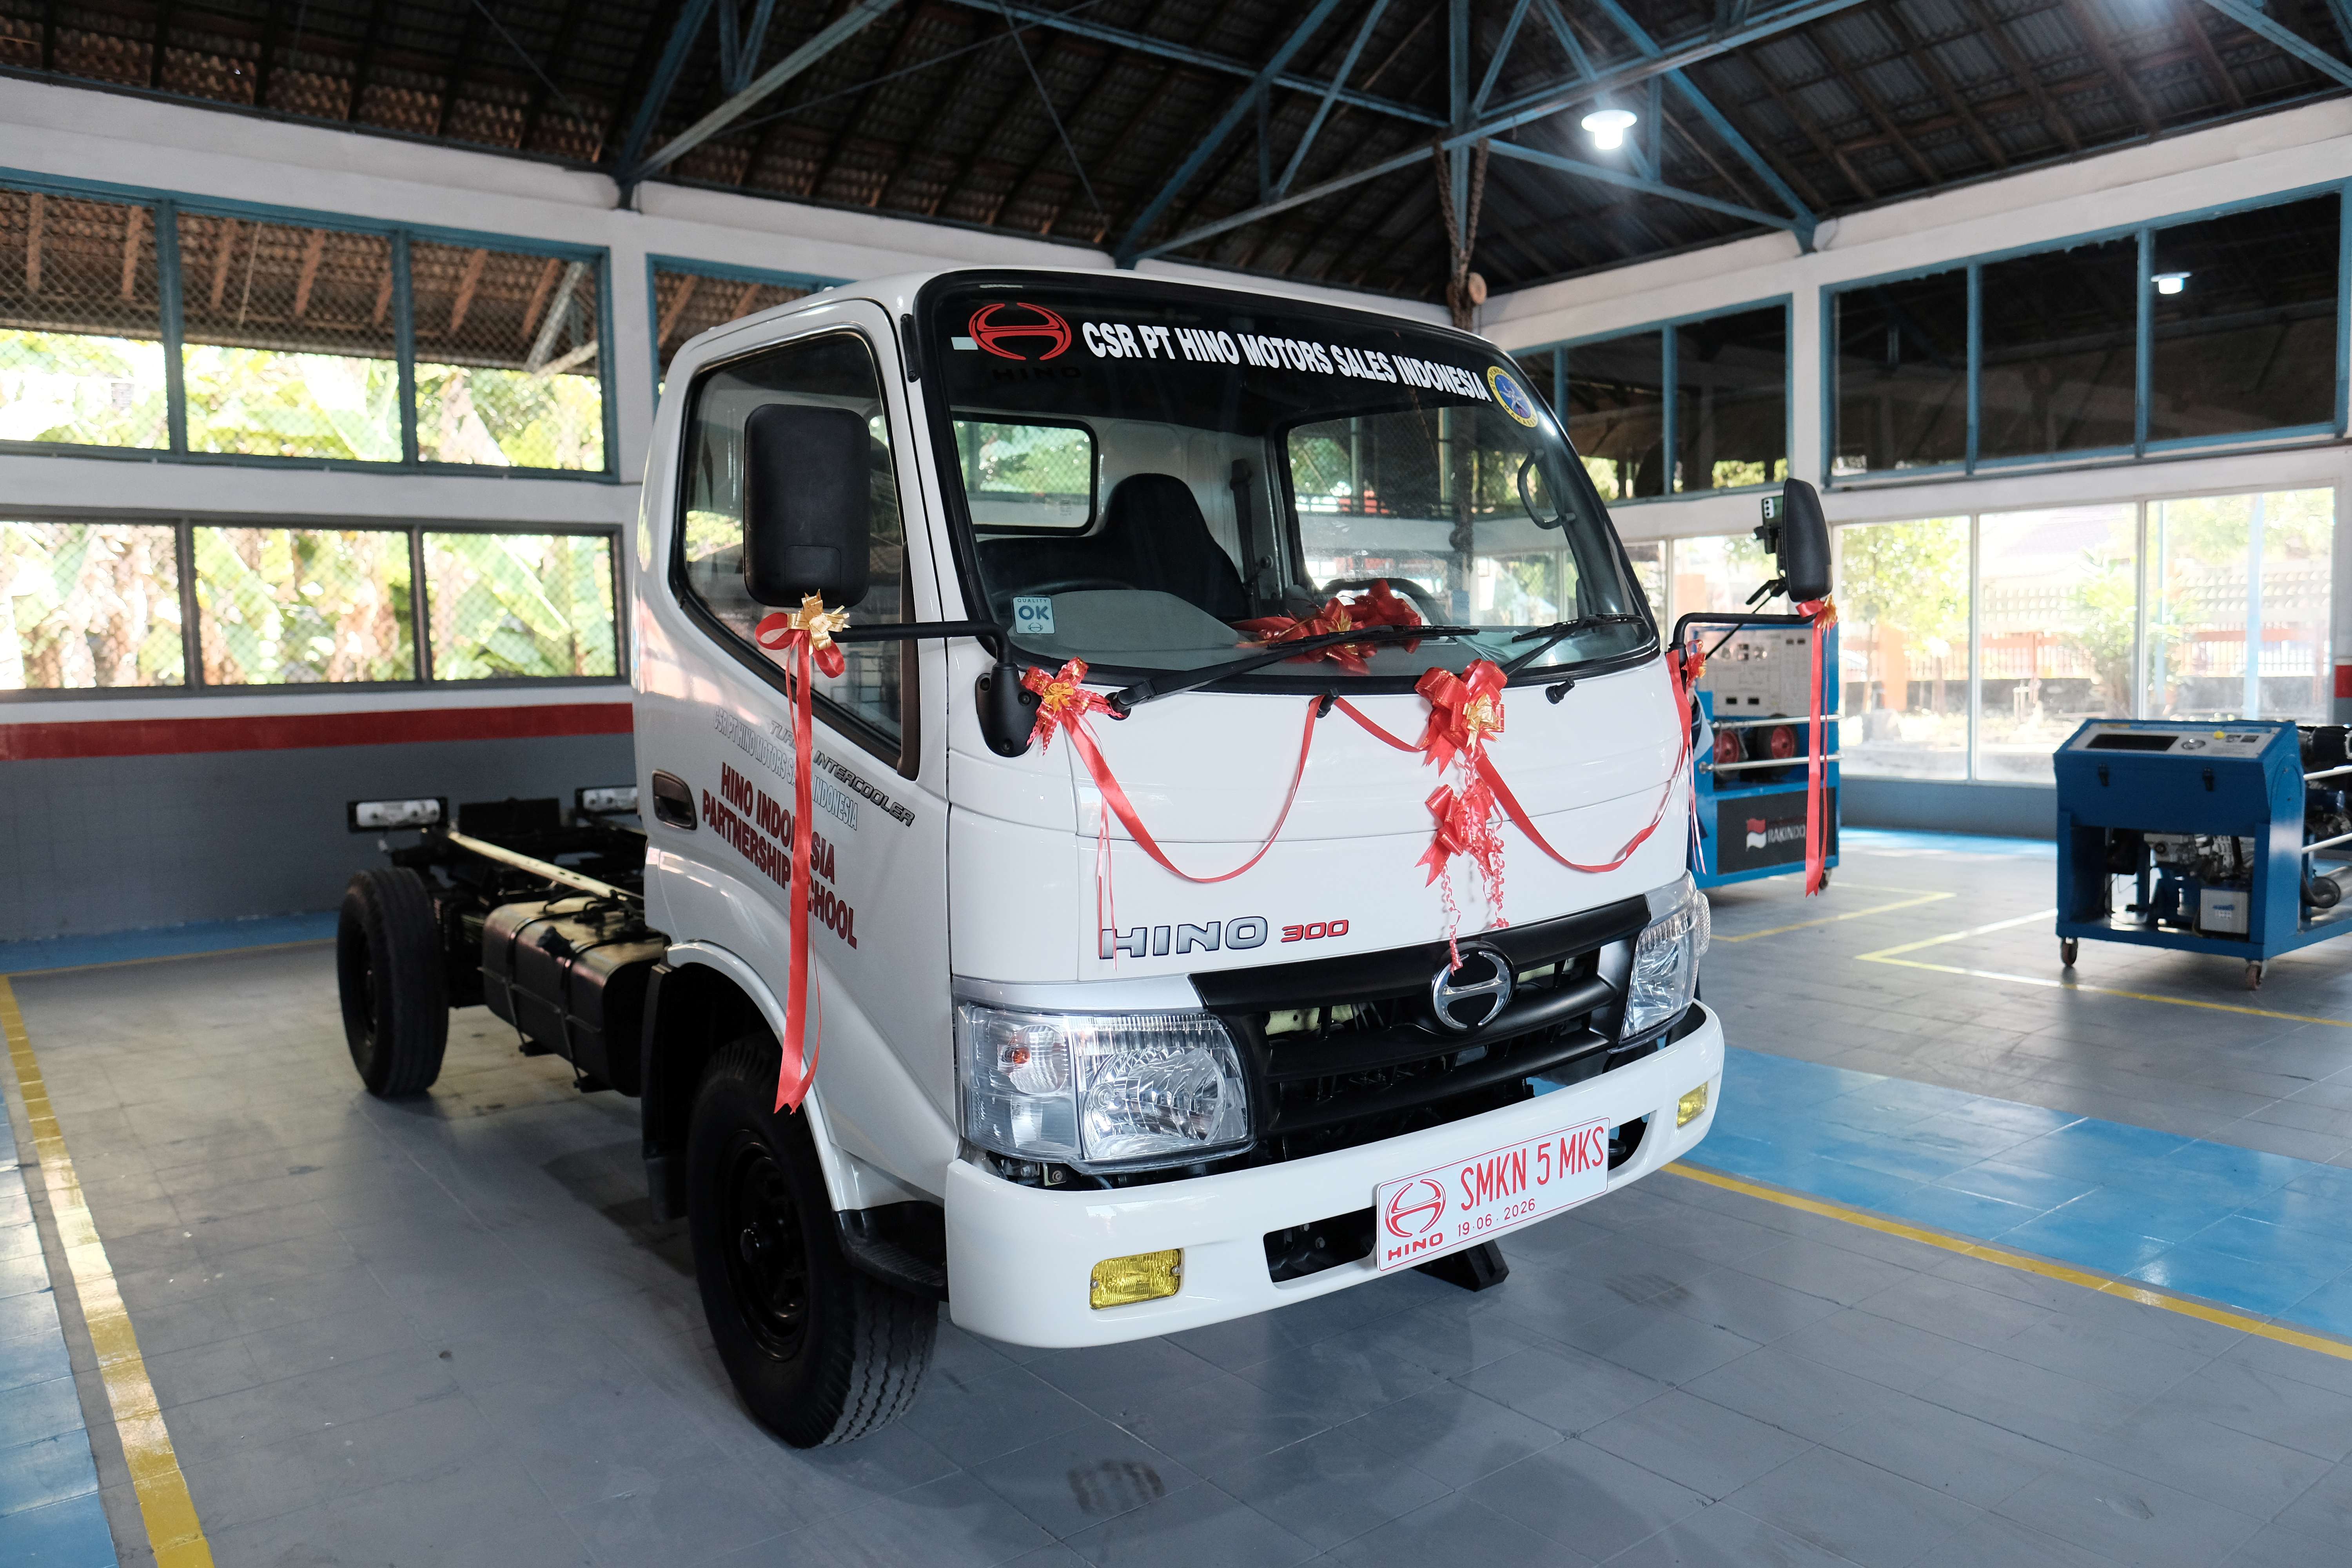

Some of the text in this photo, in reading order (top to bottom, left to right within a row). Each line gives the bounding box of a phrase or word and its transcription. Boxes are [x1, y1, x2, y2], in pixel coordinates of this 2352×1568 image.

[992, 367, 1081, 380] HINO
[1083, 322, 1142, 358] CSR
[1138, 325, 1175, 359] PT
[1174, 328, 1240, 365] HINO
[1237, 334, 1334, 374] MOTORS
[1330, 345, 1397, 383] SALES
[1392, 355, 1492, 402] INDONESIA
[1018, 605, 1049, 620] OK
[714, 705, 728, 736] CSR
[728, 715, 738, 742] PT
[737, 722, 755, 756] HINO
[755, 735, 787, 779] MOTORS
[811, 775, 858, 831] INDONESIA
[813, 750, 915, 827] INTERCOOLER
[702, 789, 791, 890] PARTNERSHIP
[721, 762, 753, 817] HINO
[756, 789, 835, 885] INDOSIA
[1099, 916, 1349, 960] HINO 300
[1461, 1126, 1604, 1210] SMKN 5 MKS
[1388, 1232, 1443, 1261] HINO
